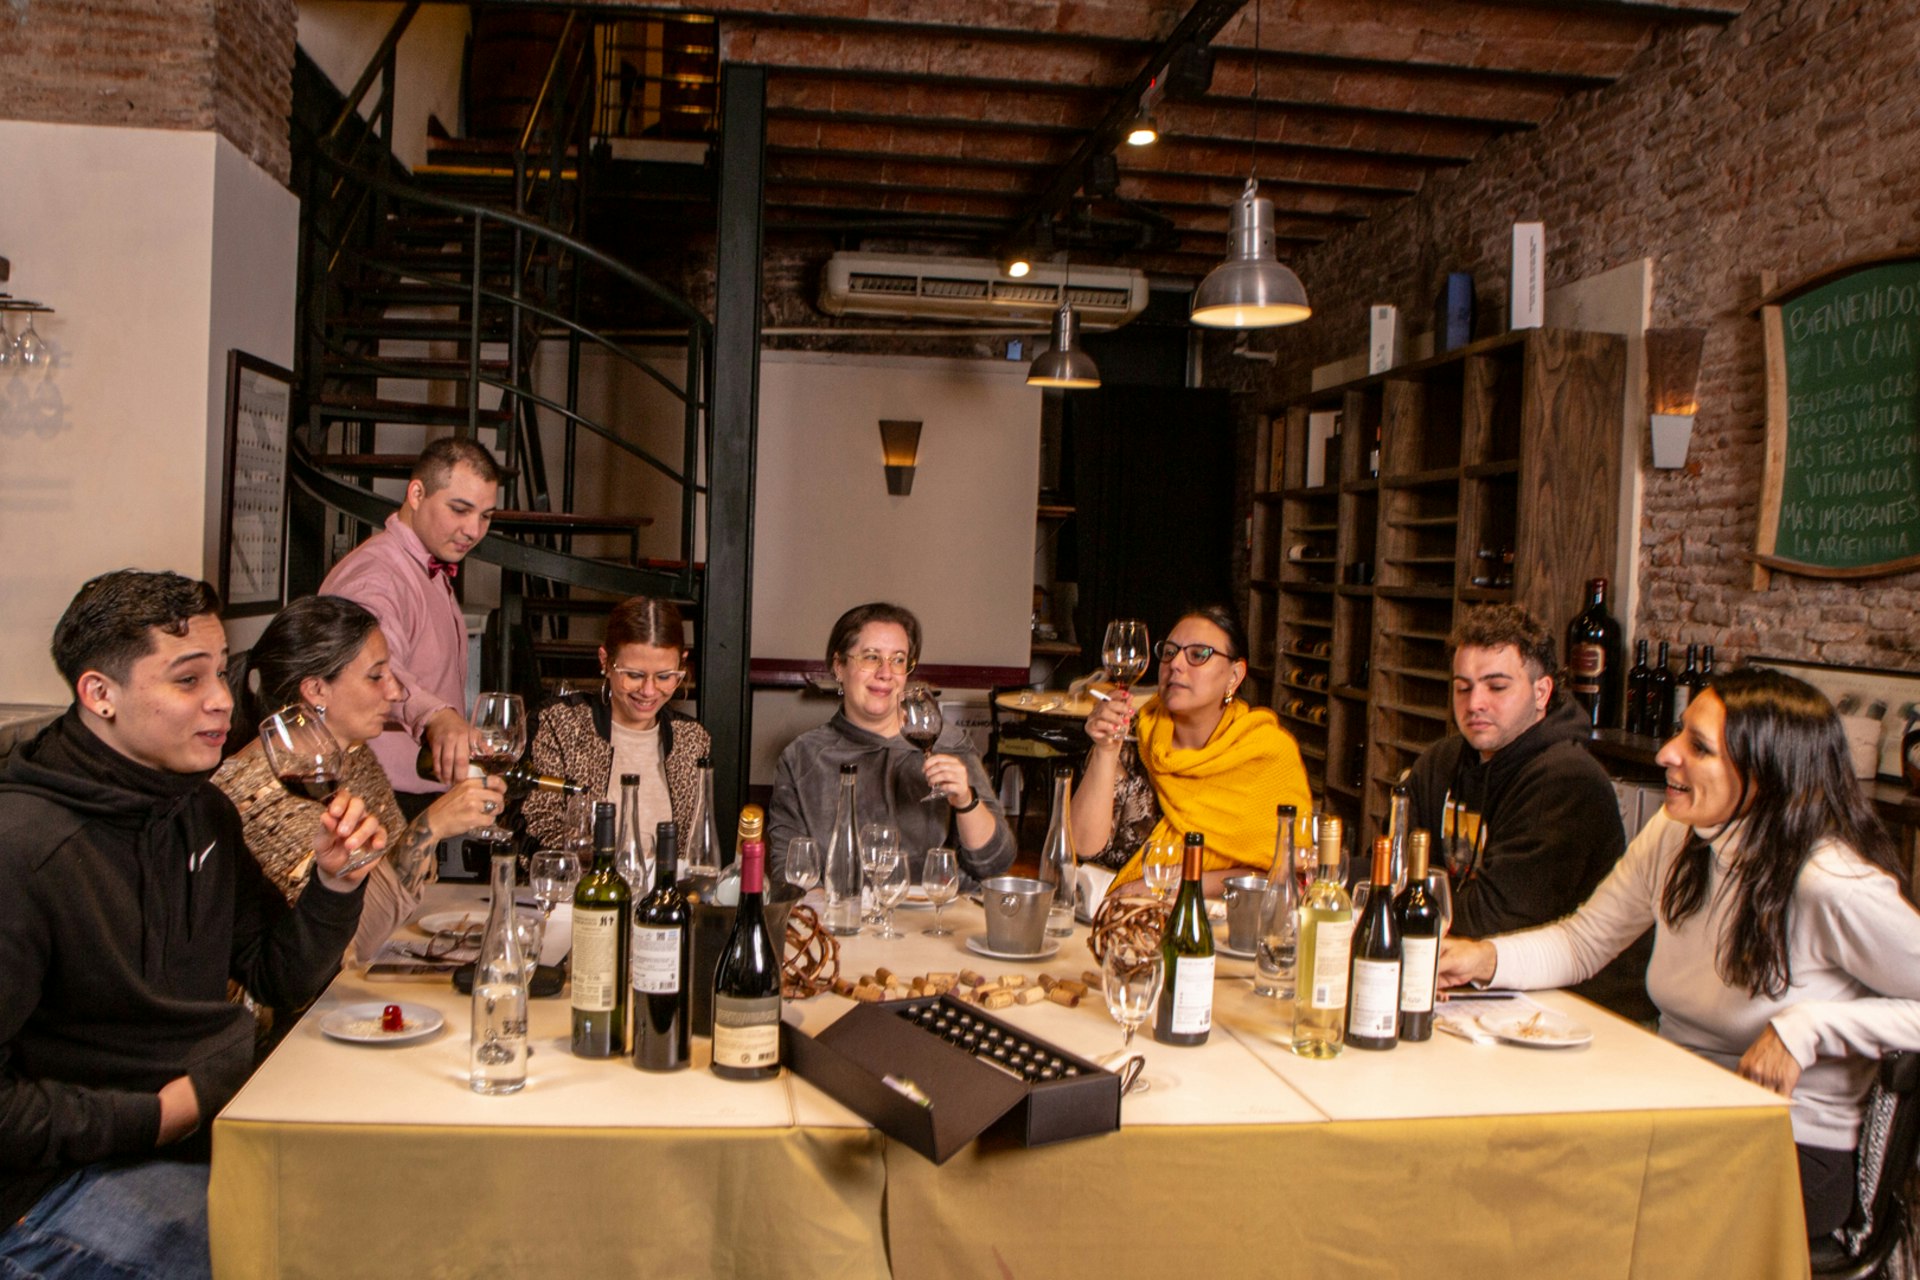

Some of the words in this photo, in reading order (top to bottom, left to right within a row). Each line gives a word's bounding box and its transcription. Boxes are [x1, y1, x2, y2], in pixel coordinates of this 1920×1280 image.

[1816, 339, 1846, 377] LA
[1853, 321, 1911, 366] CAVA
[1853, 401, 1917, 433] VIRTUAL
[1819, 439, 1856, 467] TRES
[1818, 493, 1919, 535] IMPORTANTES
